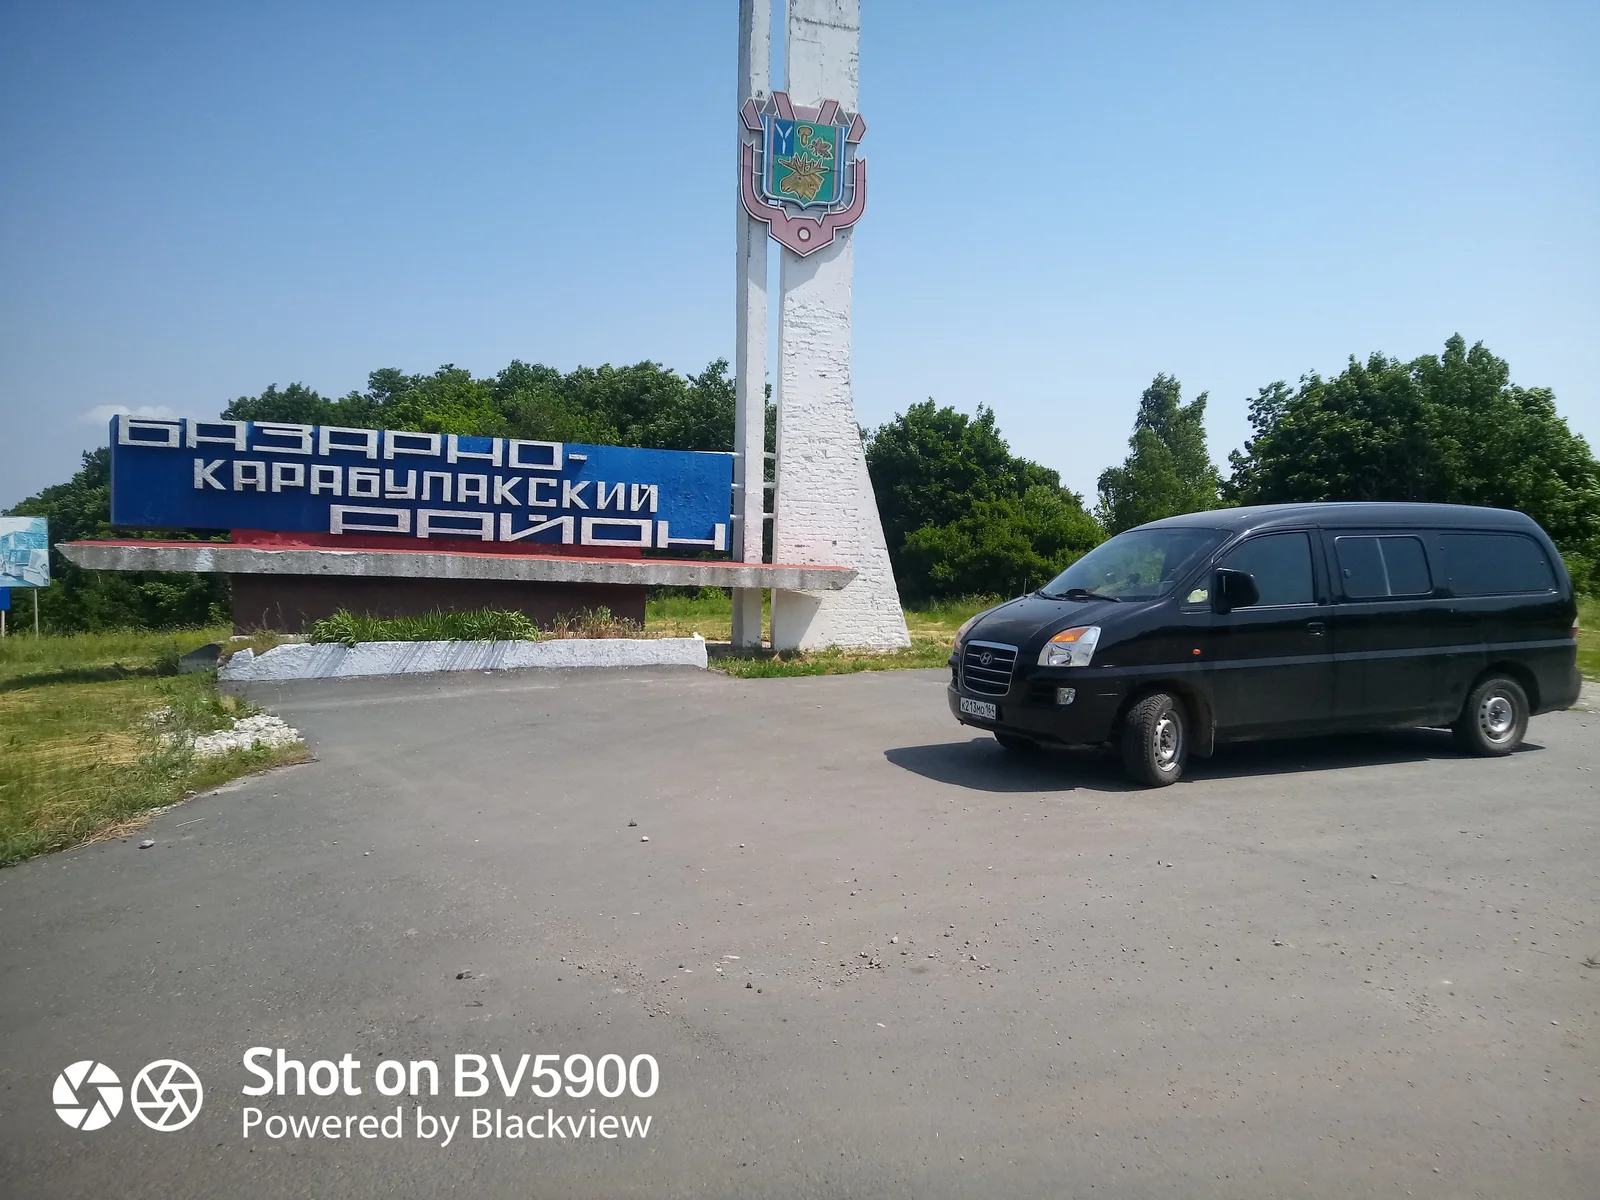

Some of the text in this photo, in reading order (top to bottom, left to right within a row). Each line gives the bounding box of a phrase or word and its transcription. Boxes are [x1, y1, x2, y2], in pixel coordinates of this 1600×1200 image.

[118, 414, 588, 471] БАЗАРНО-
[193, 457, 659, 513] КАРАБУЛАКСКИЙ
[329, 503, 726, 551] РАЙОН
